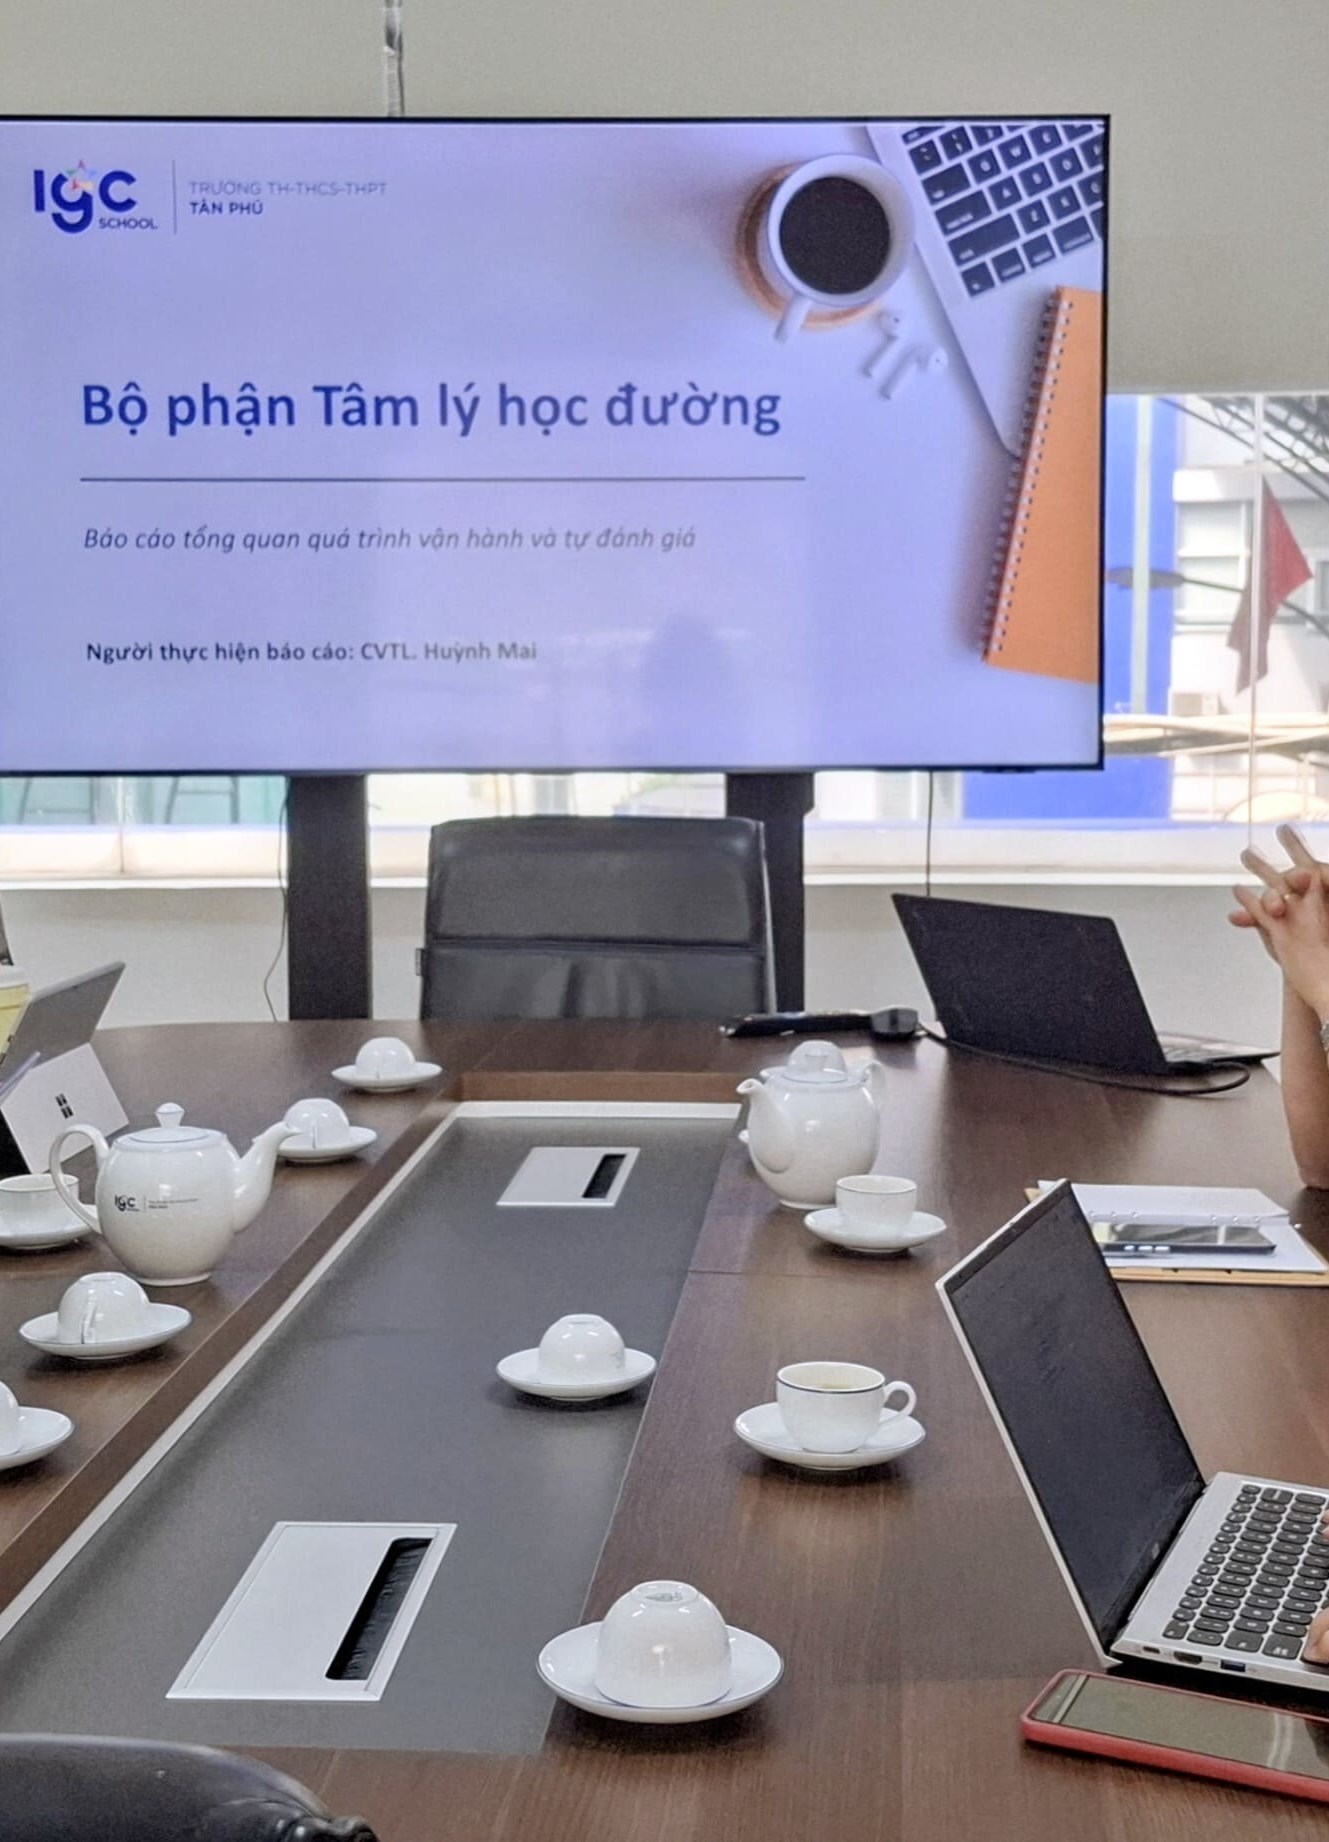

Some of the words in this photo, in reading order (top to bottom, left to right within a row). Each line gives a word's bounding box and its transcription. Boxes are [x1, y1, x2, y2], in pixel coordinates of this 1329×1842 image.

[189, 199, 224, 216] TÂN
[229, 199, 264, 216] PHÚ
[98, 217, 159, 230] SCHOOL
[83, 381, 148, 436] Bộ
[168, 382, 295, 437] phận
[312, 382, 419, 427] Tâm
[438, 382, 481, 437] lý
[499, 382, 588, 437] học
[606, 382, 782, 437] đường
[84, 527, 128, 549] Báo
[135, 527, 176, 549] cáo
[183, 524, 235, 553] tổng
[242, 531, 300, 553] quan
[307, 527, 351, 553] quá
[358, 527, 411, 549] trình
[419, 527, 460, 551] vận
[466, 527, 524, 548] hành
[531, 528, 558, 548] và
[564, 531, 591, 552] tự
[596, 527, 655, 548] đánh
[661, 526, 697, 553] giá
[86, 642, 154, 666] Người
[160, 642, 209, 664] thực
[215, 642, 260, 664] hiện
[266, 642, 306, 661] báo
[311, 642, 355, 661] cáo:
[360, 642, 418, 661] CVTL.
[424, 641, 491, 665] Huỳnh
[497, 642, 538, 661] Mai
